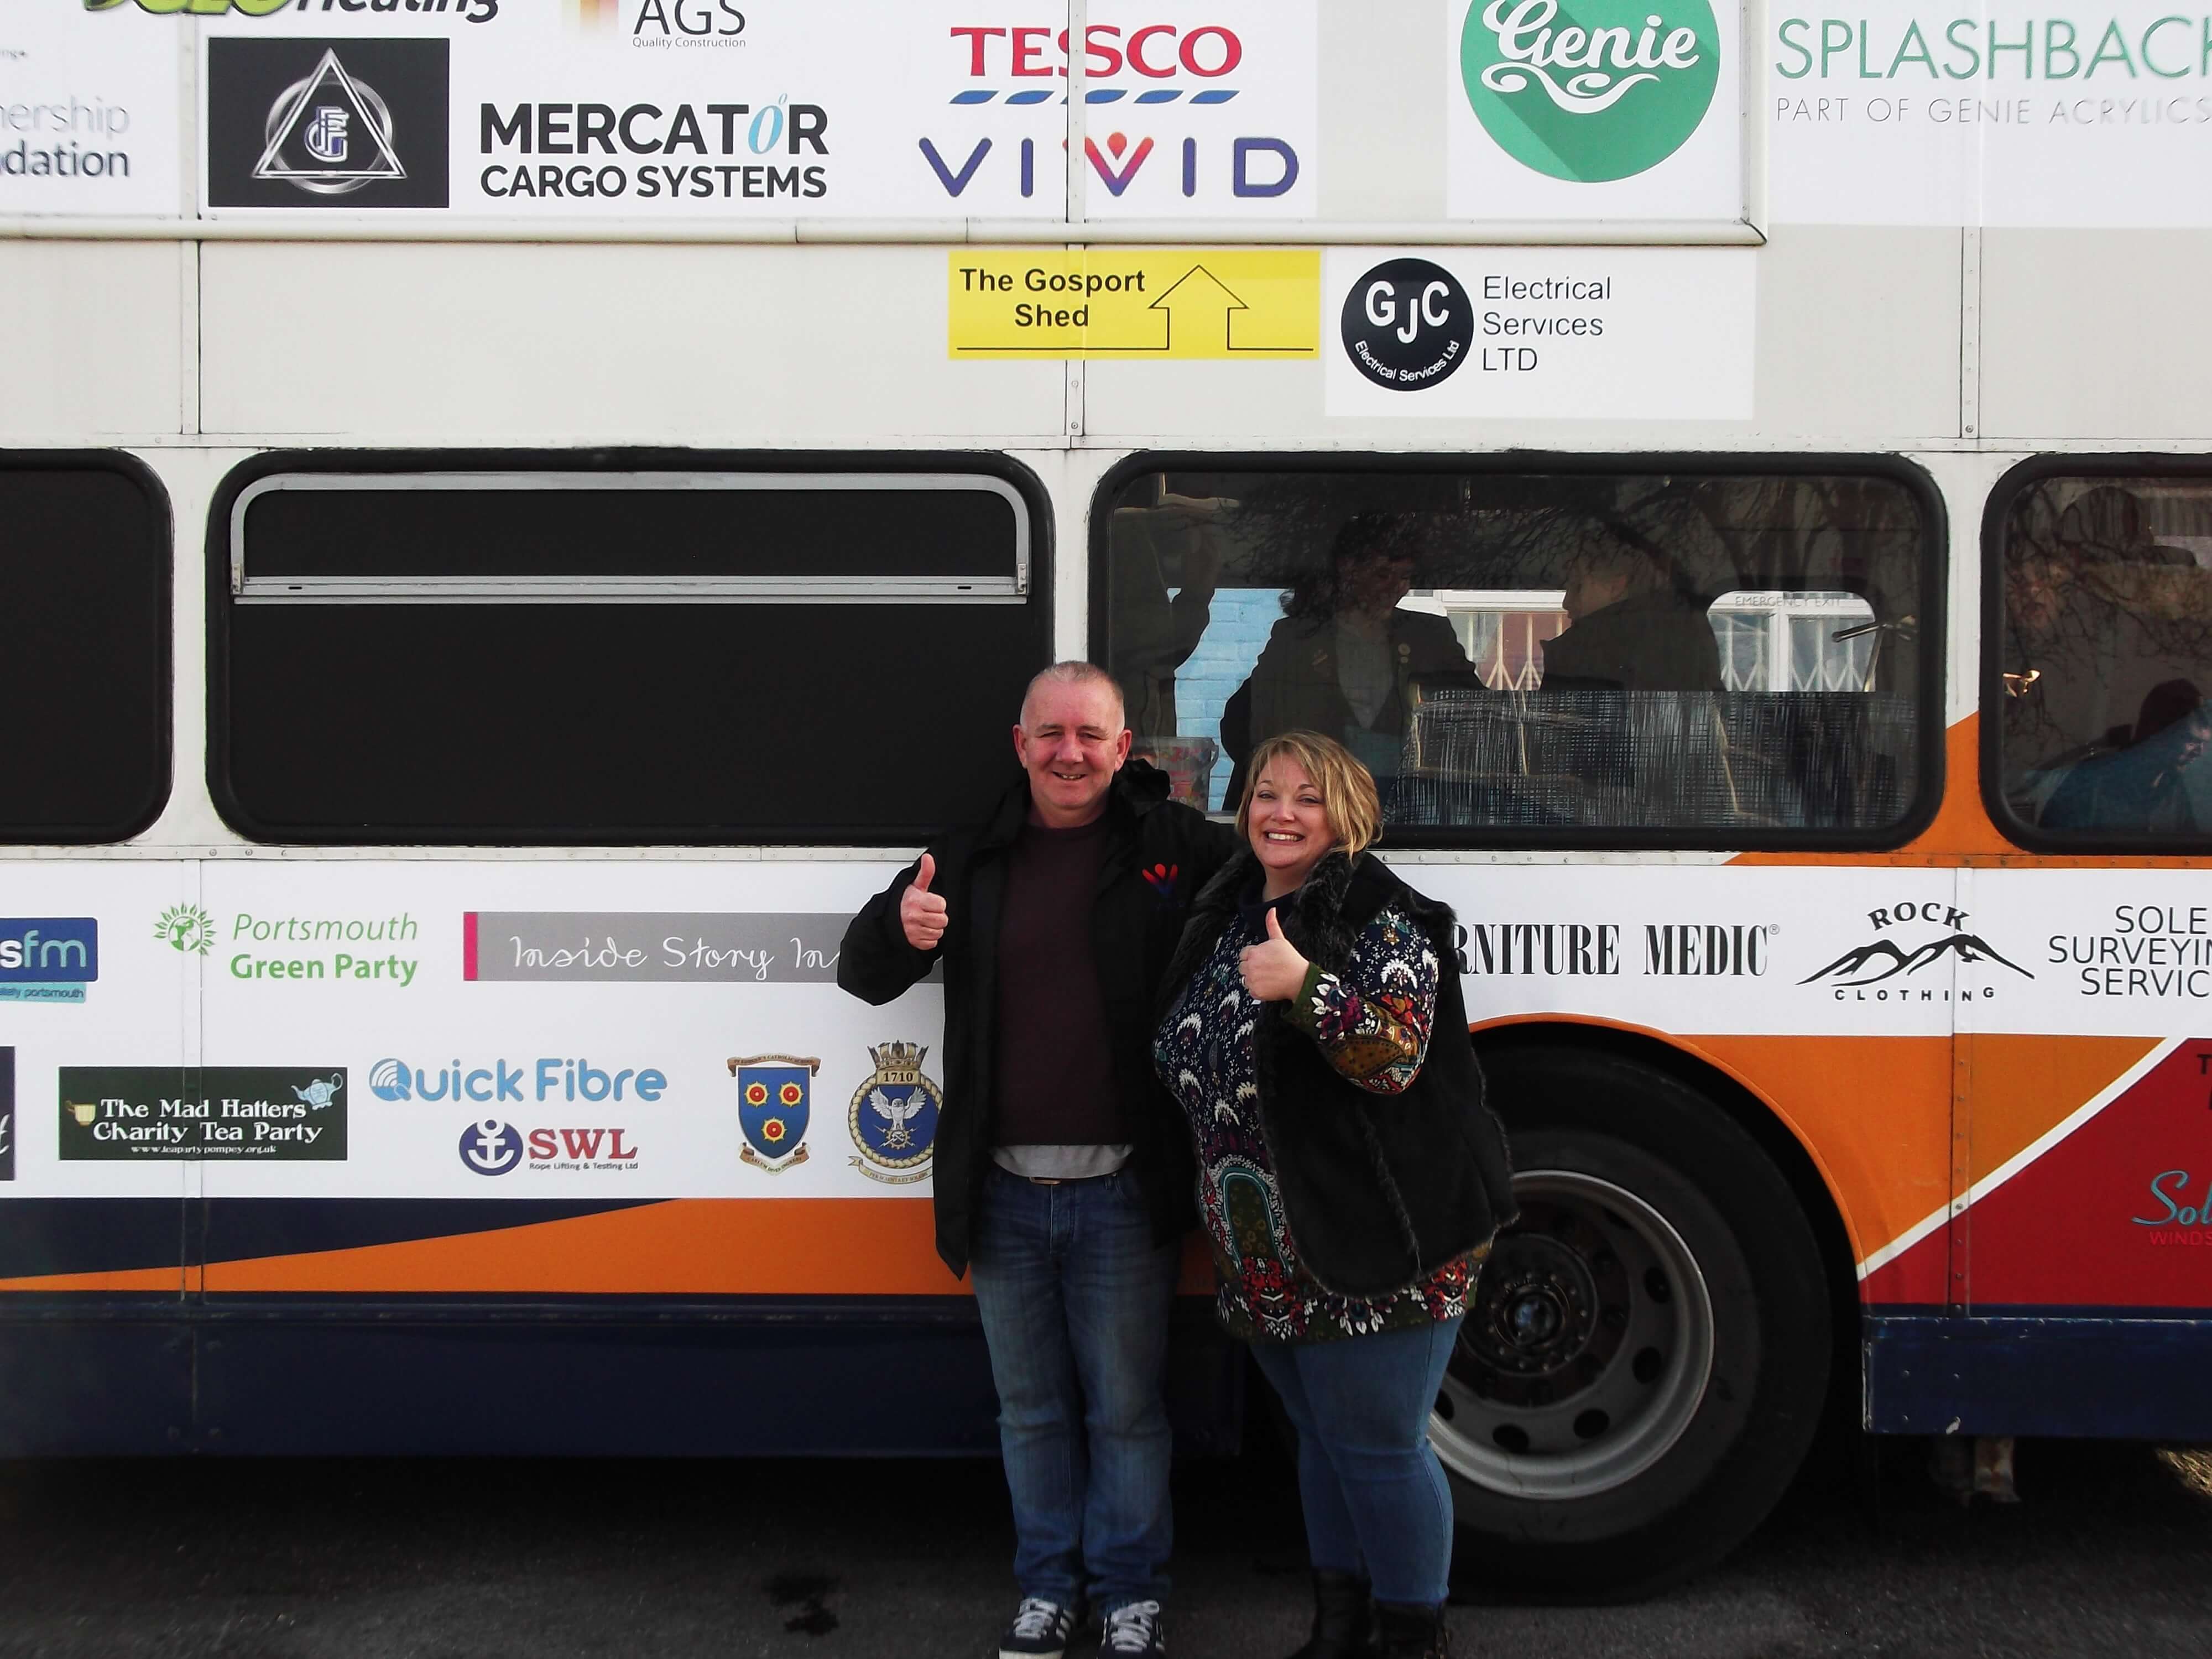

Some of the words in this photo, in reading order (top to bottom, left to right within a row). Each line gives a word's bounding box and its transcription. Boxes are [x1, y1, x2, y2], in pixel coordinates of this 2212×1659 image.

[633, 0, 745, 35] AGS
[633, 37, 671, 49] Quality
[675, 37, 746, 48] Construction
[1483, 0, 1700, 69] Genie
[950, 25, 1242, 78] TESCO
[1777, 98, 1849, 122] PART
[1866, 98, 1910, 122] OF
[1928, 98, 2030, 123] GENIE
[2049, 97, 2212, 124] ACRYLICS
[0, 139, 131, 176] dation
[919, 132, 1299, 198] VIVID
[481, 165, 627, 197] CARGO
[636, 165, 827, 197] SYSTEMS
[959, 269, 1013, 291] The
[1025, 269, 1145, 298] Gosport
[1484, 276, 1610, 299] Electrical
[1015, 304, 1089, 326] Shed
[1365, 280, 1450, 344] GJC
[1483, 312, 1603, 336] Services
[1355, 340, 1397, 380] Electrical
[1399, 358, 1447, 382] Services
[1442, 340, 1460, 360] Ltd
[1483, 347, 1538, 371] LTD
[1735, 596, 1809, 607] EMERGENCY
[1814, 598, 1840, 607] EXIT
[232, 912, 419, 941] Portsmouth
[1867, 901, 1970, 931] ROCK
[2115, 905, 2208, 935] SOLE
[230, 954, 325, 979] Green
[335, 954, 419, 987] Party
[510, 936, 649, 968] Inside
[664, 936, 774, 980] Story
[1835, 987, 1995, 1001] CLOTHING
[2080, 967, 2210, 998] SERVIC
[369, 1058, 524, 1102] Quick
[536, 1058, 667, 1102] Fibre
[883, 1072, 914, 1082] 1710
[100, 1099, 149, 1118] The
[159, 1099, 210, 1118] Mad
[221, 1099, 306, 1119] Hatters
[93, 1121, 189, 1143] Charity
[200, 1121, 243, 1141] Tea
[254, 1121, 323, 1143] Party
[528, 1128, 638, 1160] SWL
[529, 1162, 551, 1172] Rope
[554, 1162, 581, 1171] Lifting
[593, 1162, 623, 1171] Testing
